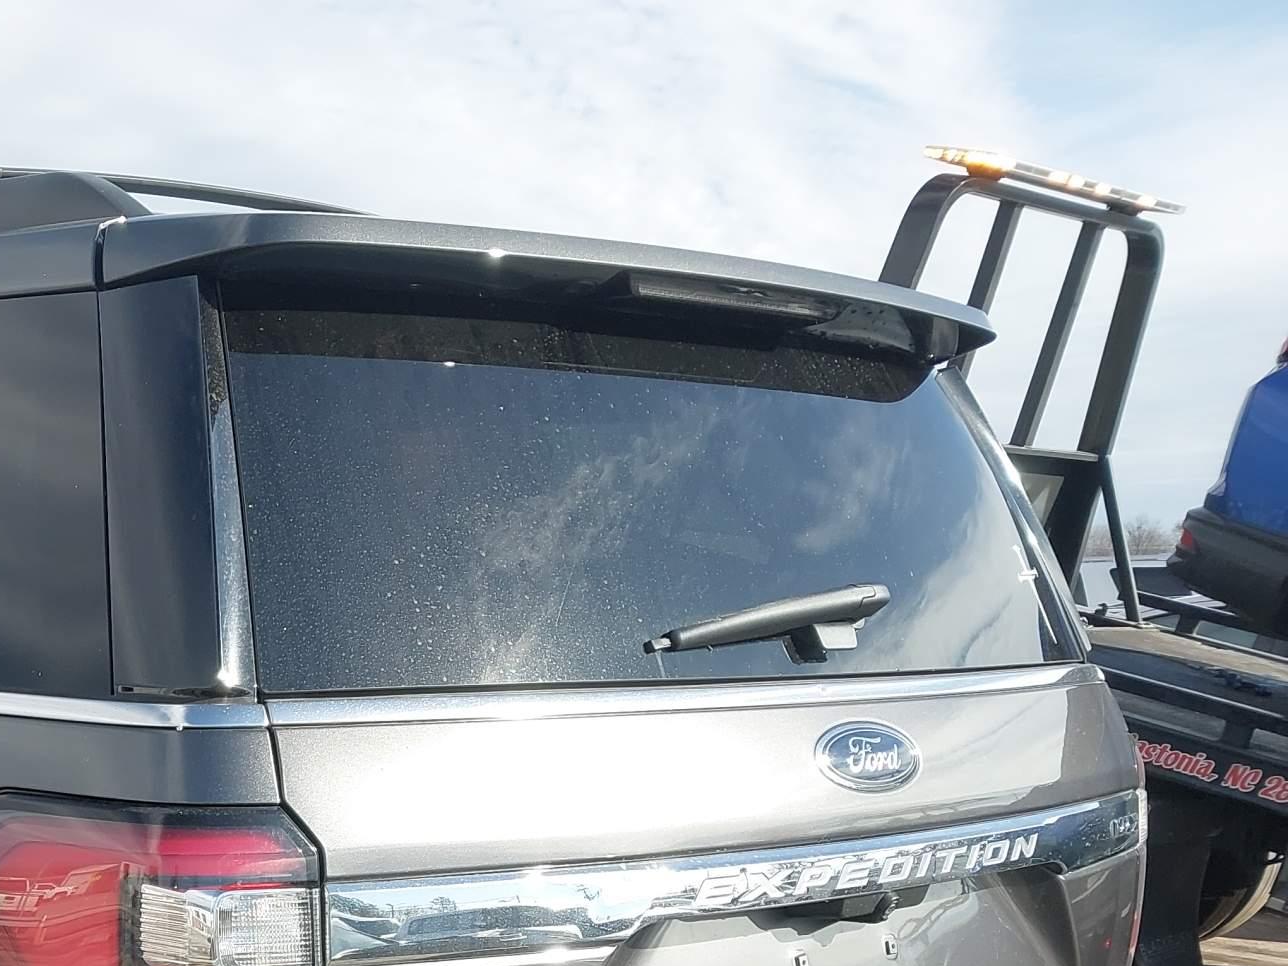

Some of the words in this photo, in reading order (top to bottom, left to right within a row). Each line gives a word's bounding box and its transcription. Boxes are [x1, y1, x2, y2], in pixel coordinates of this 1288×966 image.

[848, 736, 902, 773] Ford
[1136, 740, 1219, 782] astonia,
[1222, 763, 1263, 792] NC
[694, 832, 1040, 906] EXPEDITION
